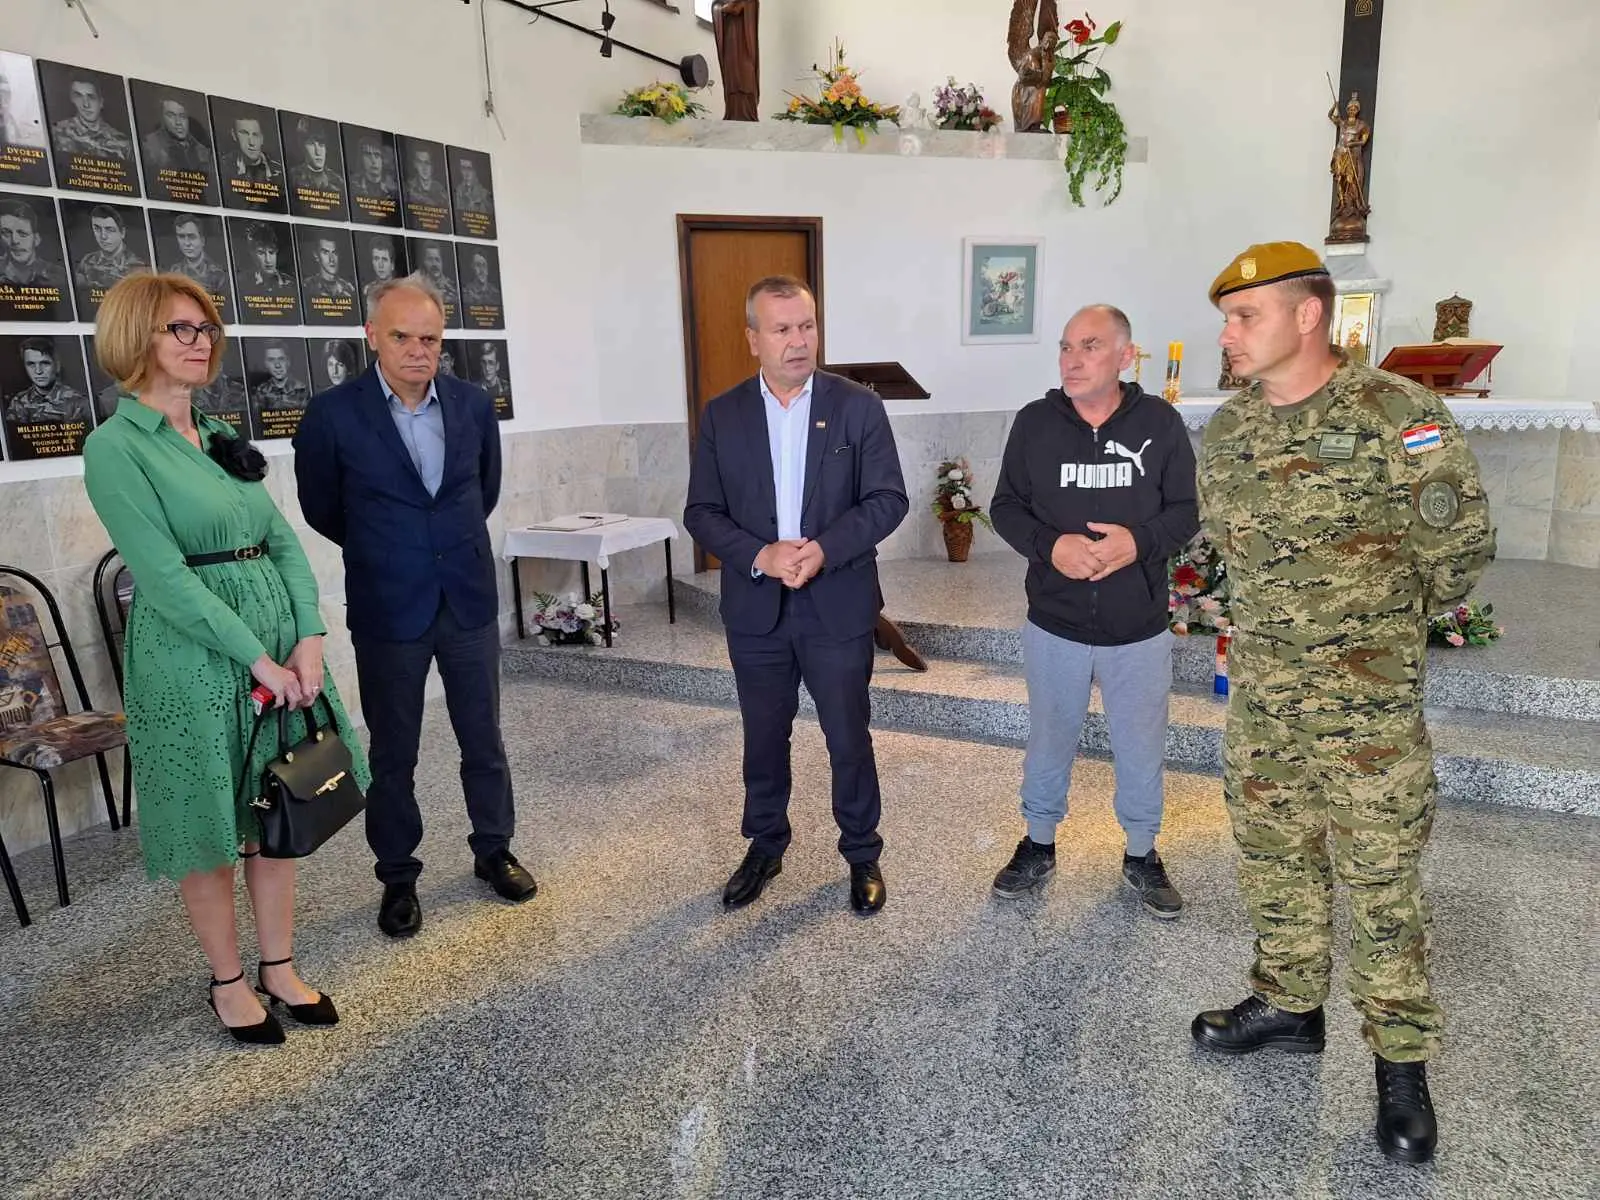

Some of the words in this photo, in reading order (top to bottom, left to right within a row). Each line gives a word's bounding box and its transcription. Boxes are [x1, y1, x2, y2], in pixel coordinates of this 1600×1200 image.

[73, 157, 94, 166] IVAN
[0, 284, 15, 295] AŠA
[17, 424, 57, 434] MILJENKO
[1060, 462, 1132, 489] PUMA
